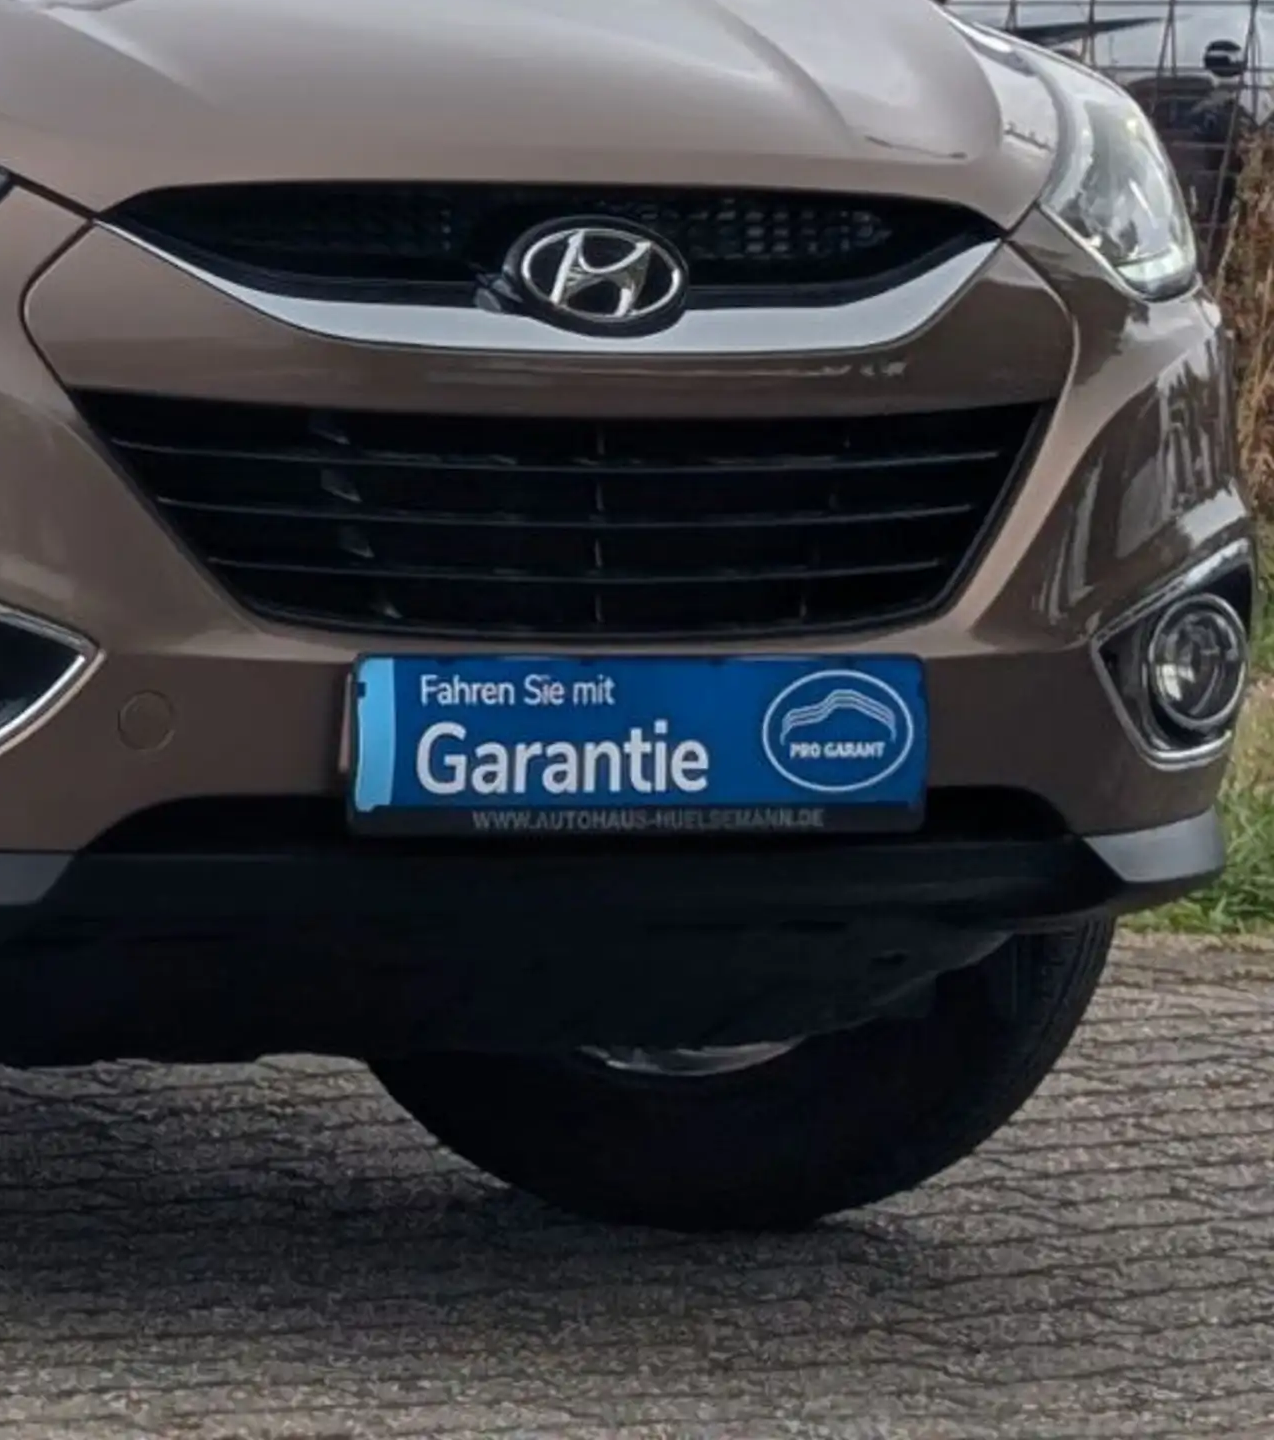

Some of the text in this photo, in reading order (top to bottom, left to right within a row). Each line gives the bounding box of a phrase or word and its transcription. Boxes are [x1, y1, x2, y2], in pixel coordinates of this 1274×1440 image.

[420, 673, 616, 707] Fahren Sie mit
[416, 719, 710, 796] Garantie
[789, 741, 886, 761] PRO GARANT
